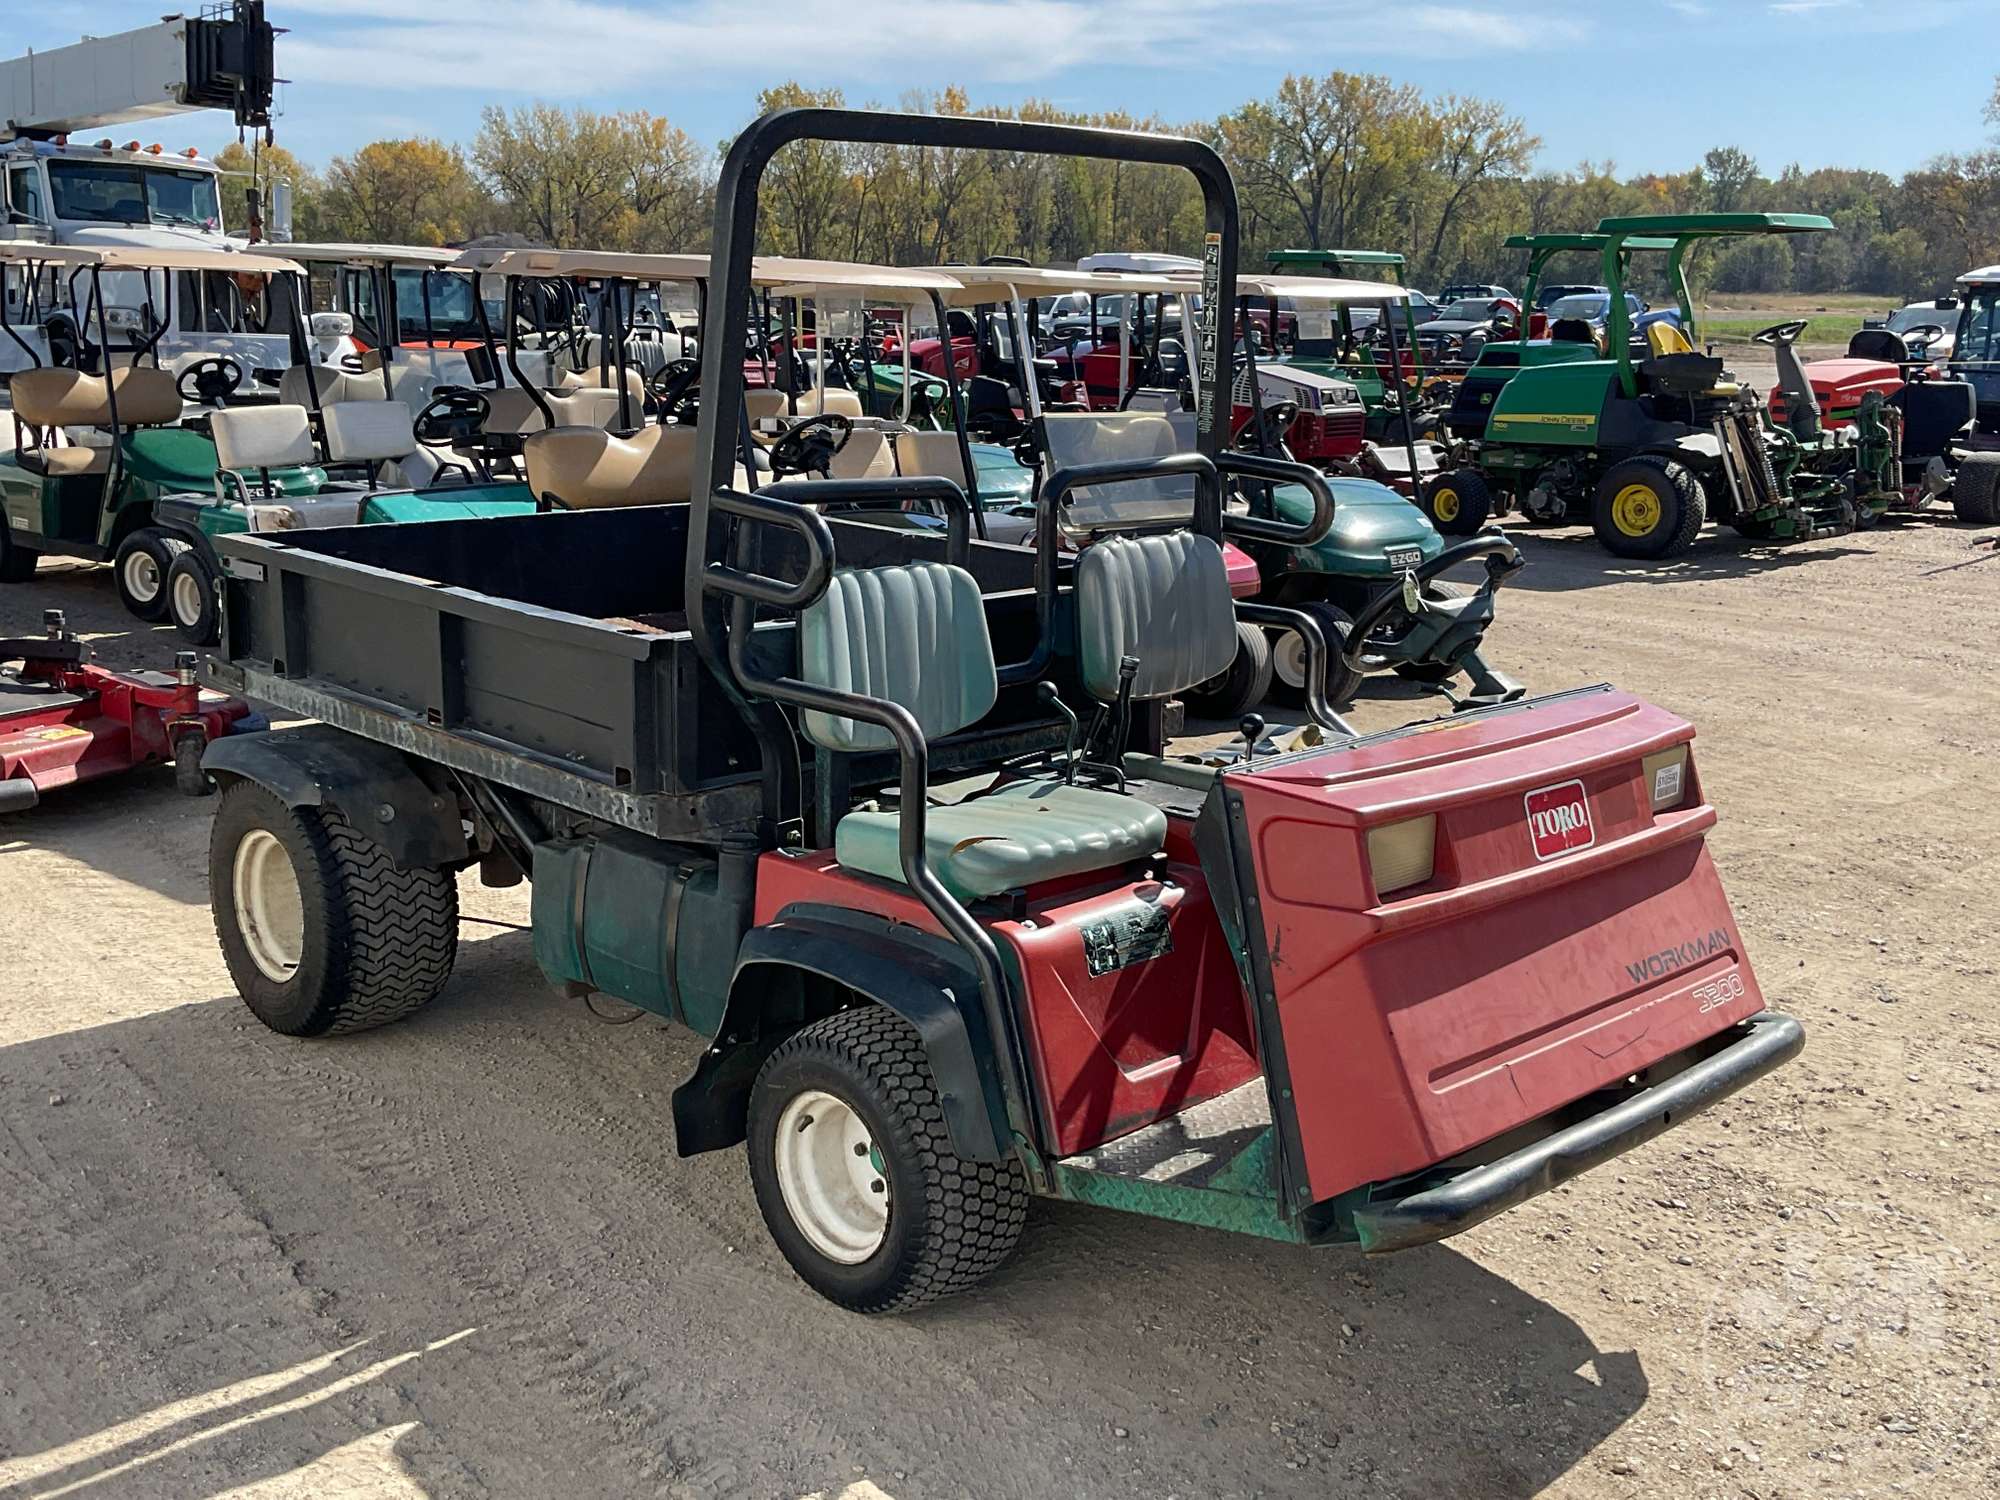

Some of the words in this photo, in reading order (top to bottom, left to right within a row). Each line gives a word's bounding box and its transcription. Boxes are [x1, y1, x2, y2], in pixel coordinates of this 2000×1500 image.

[1541, 416, 1560, 424] JOHN
[1561, 416, 1587, 424] DEERE
[1531, 802, 1585, 838] TORO
[1625, 927, 1732, 984] WORKMAN
[1692, 973, 1744, 1014] 3200
